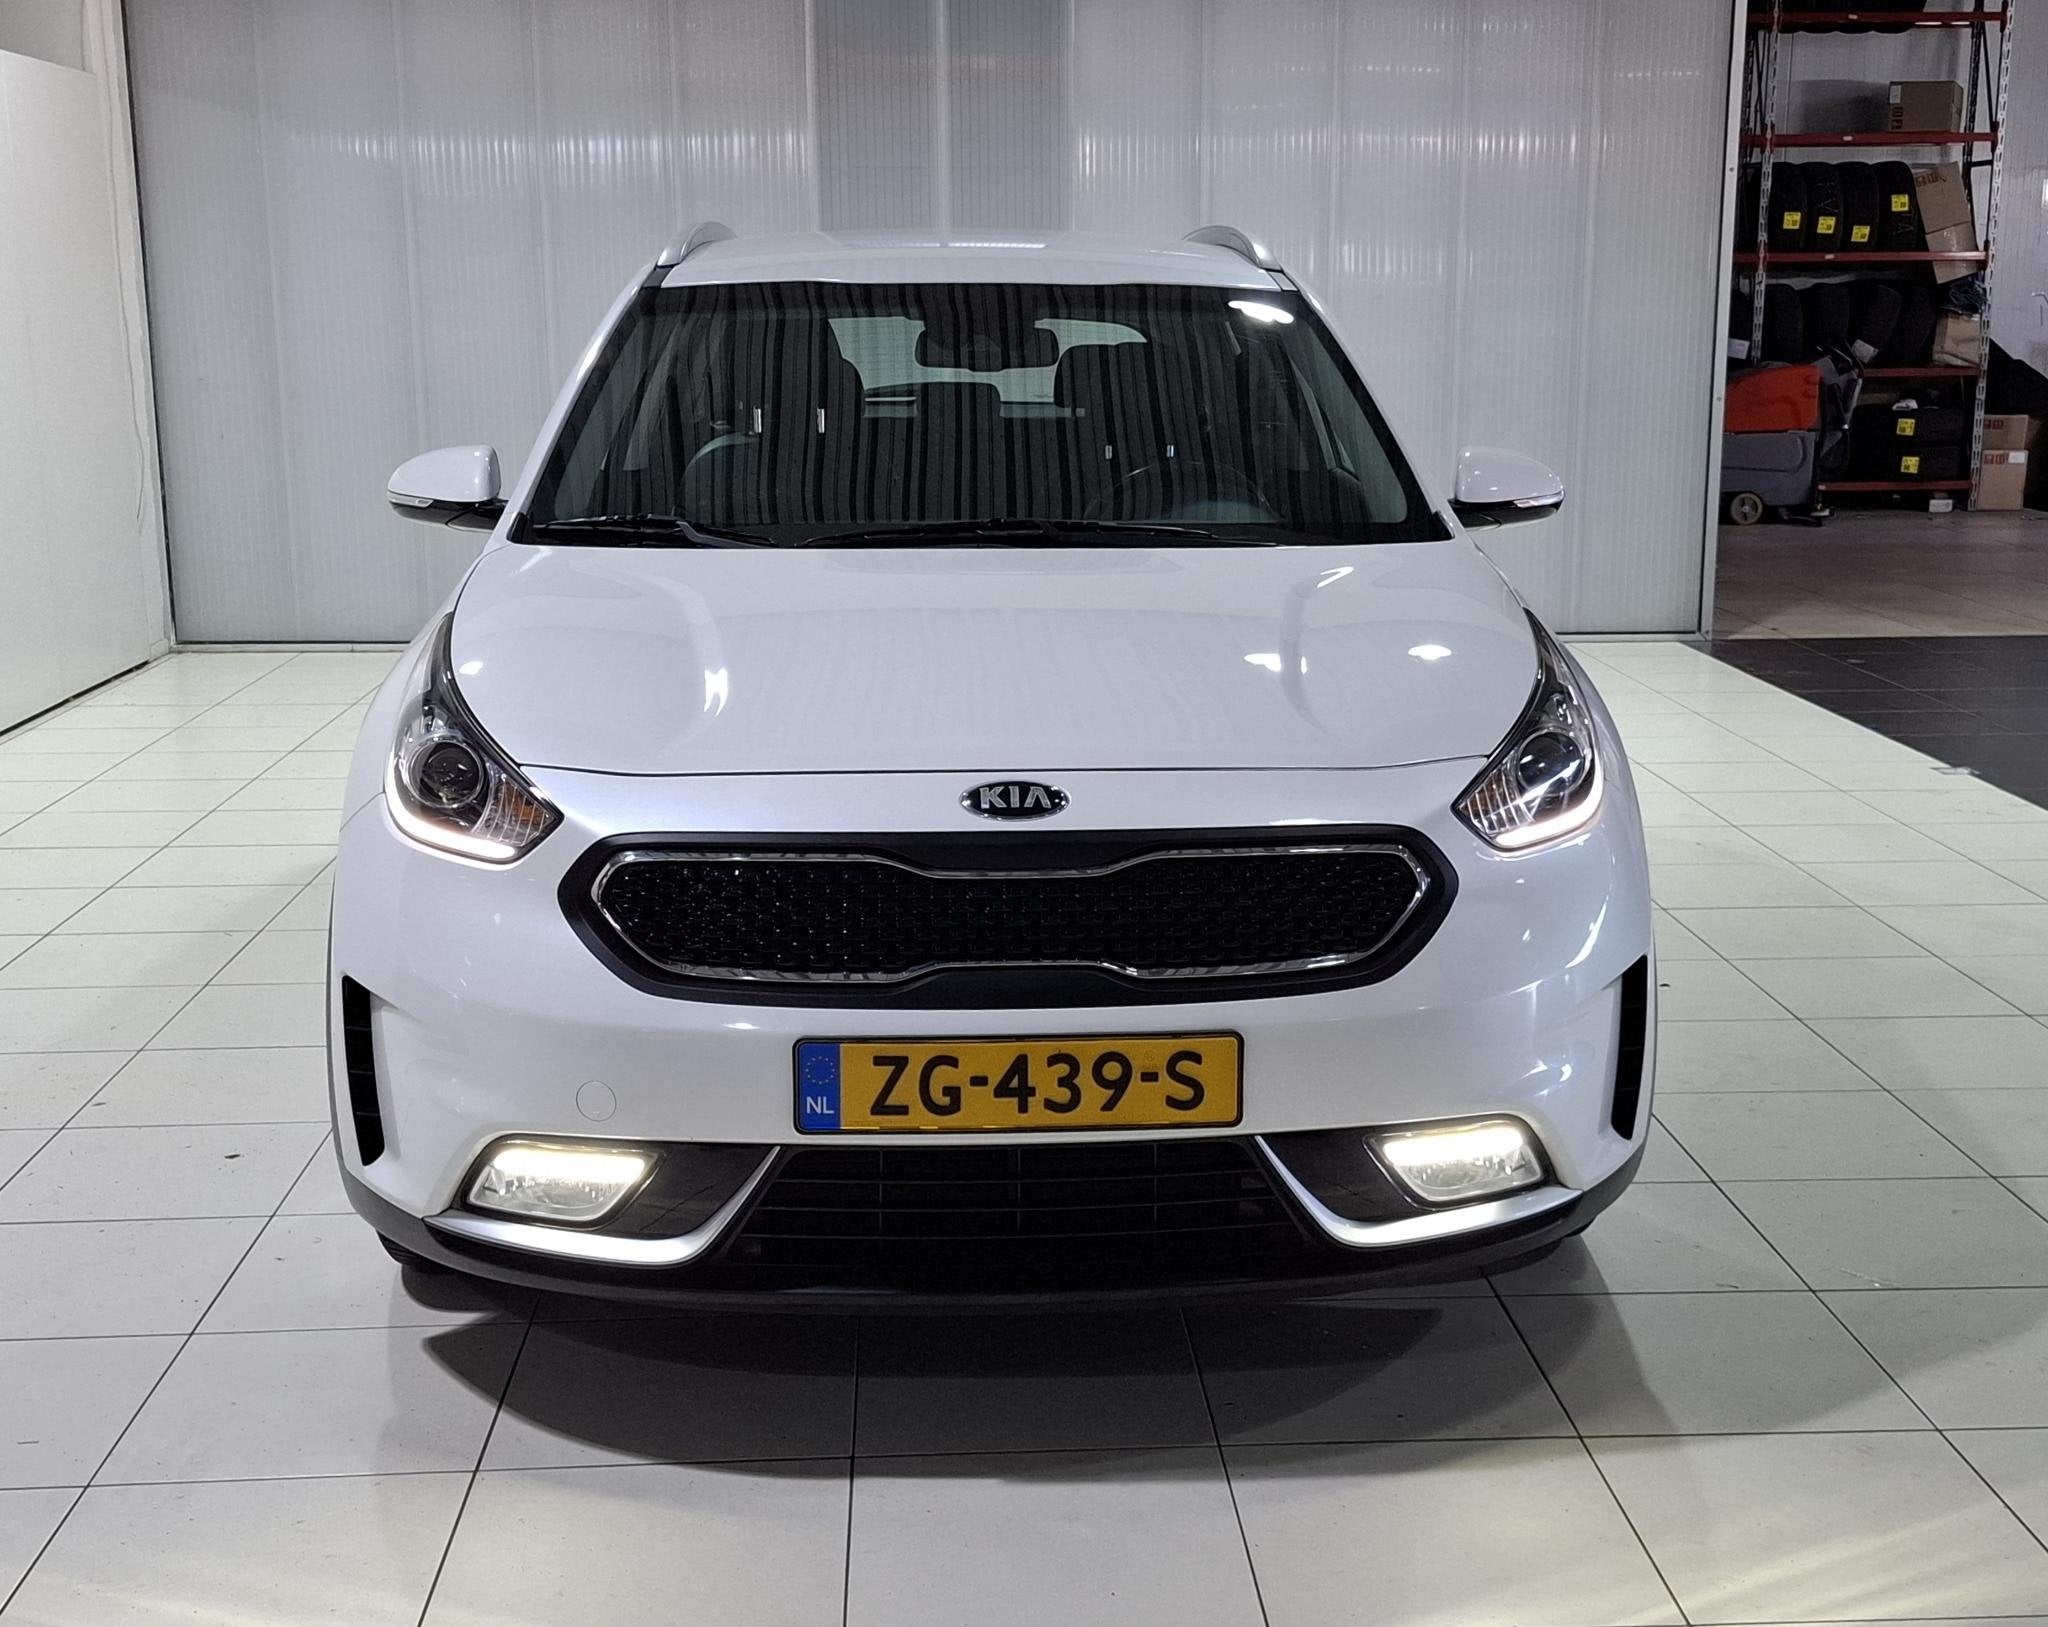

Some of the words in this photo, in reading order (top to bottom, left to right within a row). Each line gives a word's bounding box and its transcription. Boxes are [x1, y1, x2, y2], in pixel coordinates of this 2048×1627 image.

[979, 785, 1052, 809] KIA
[869, 1050, 1206, 1117] ZG-439-S
[806, 1096, 835, 1114] NL
